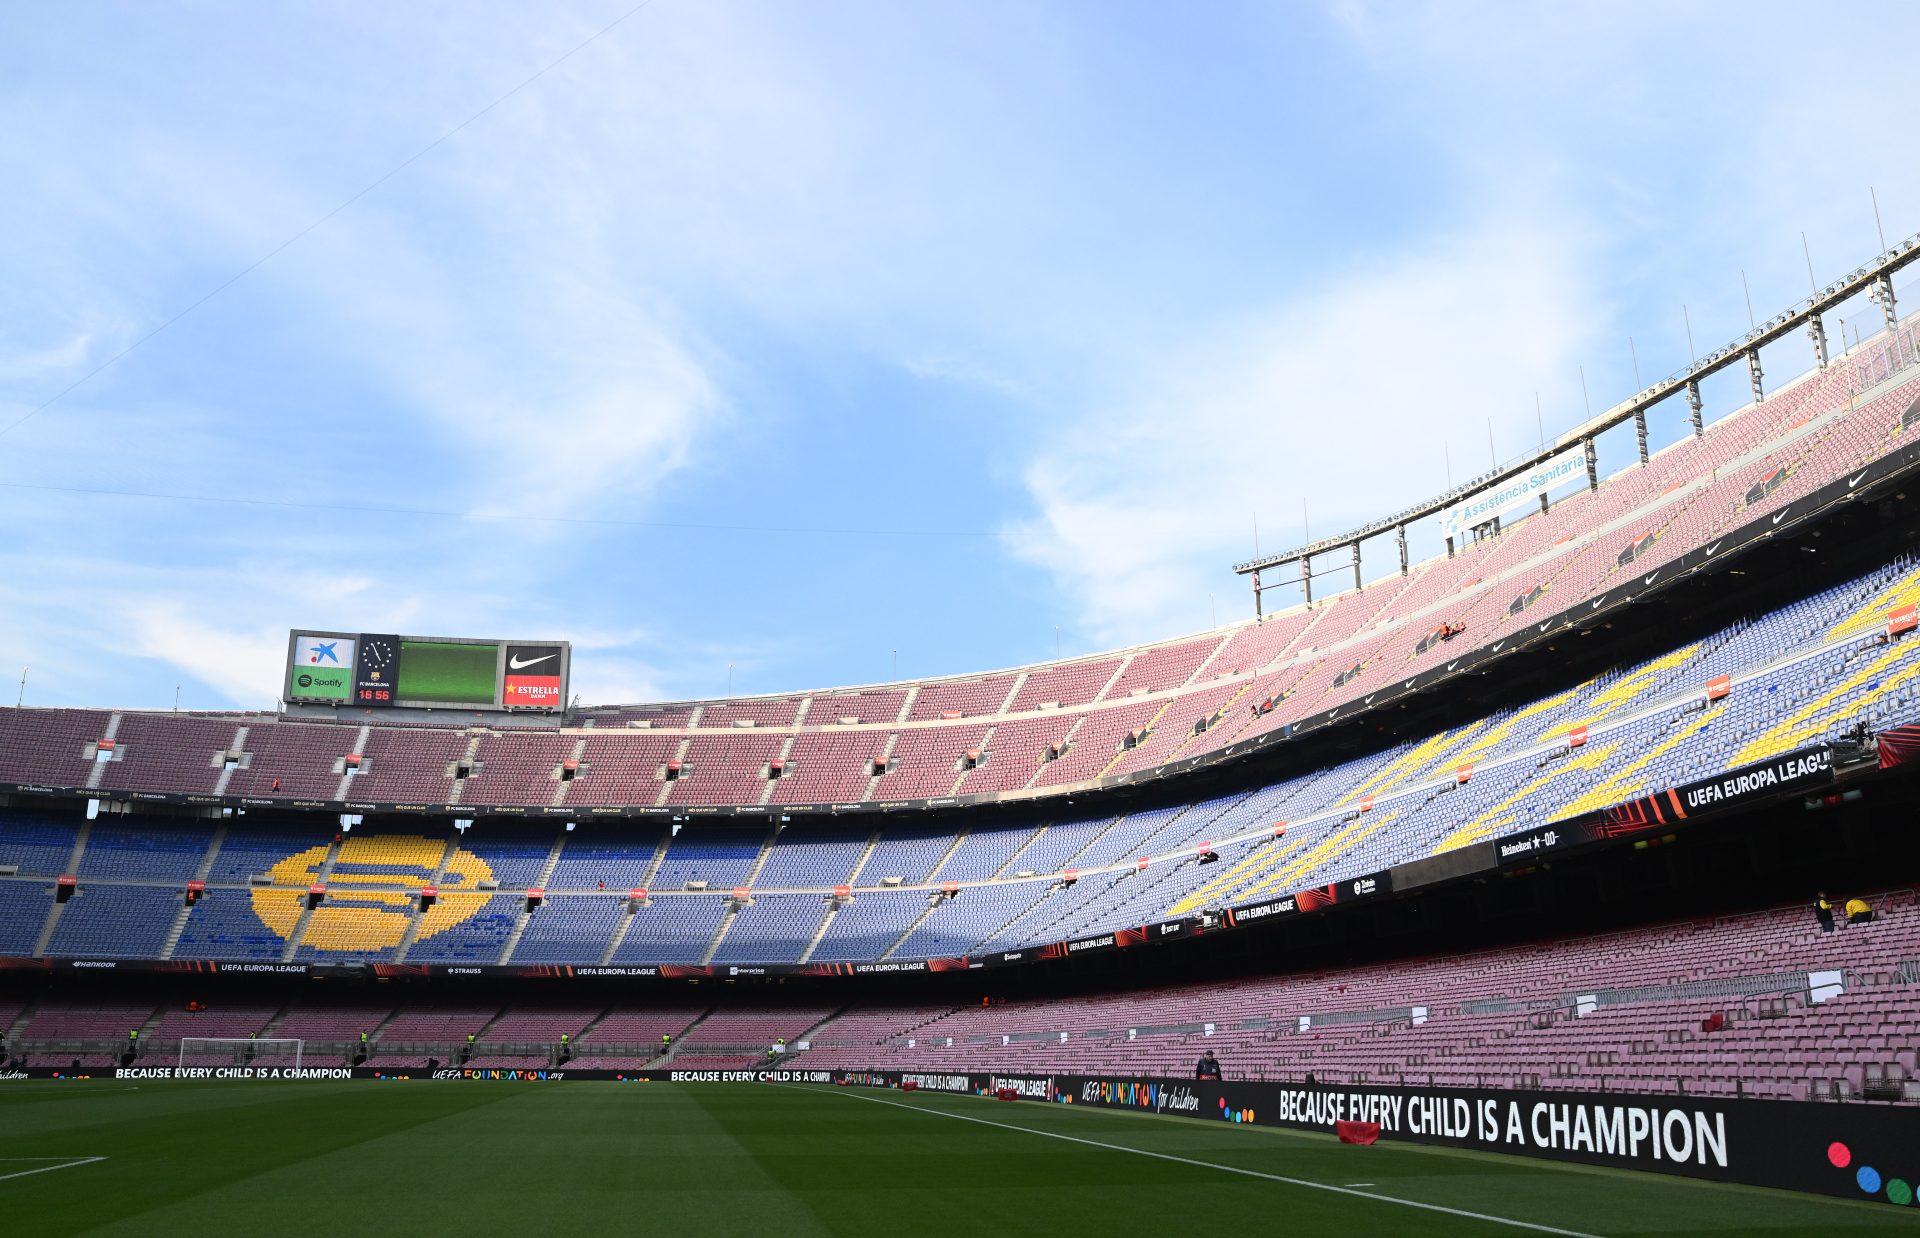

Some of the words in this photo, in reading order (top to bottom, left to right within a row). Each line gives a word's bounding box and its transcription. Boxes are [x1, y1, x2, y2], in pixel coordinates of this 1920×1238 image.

[313, 679, 342, 688] Spotify
[518, 687, 559, 695] ESTRELLA
[1688, 784, 1723, 807] UEFA
[1724, 768, 1778, 797] EUROPA
[1778, 750, 1832, 781] LEAGU
[1501, 841, 1532, 856] Heineken
[1235, 910, 1250, 921] UEFA
[1251, 905, 1272, 918] EUROPA
[1272, 899, 1294, 914] LEAGUE
[1080, 940, 1097, 950] EUROPA
[1097, 936, 1114, 947] LEAGUE
[244, 964, 275, 972] EUROPA
[901, 962, 925, 971] LEAGUE
[116, 1068, 171, 1078] BECAUSE
[174, 1068, 213, 1078] EVERY
[216, 1068, 253, 1078] CHILD
[257, 1068, 268, 1078] IS
[271, 1068, 280, 1078] A
[283, 1069, 352, 1079] CHAMPION
[432, 1070, 461, 1080] UEFA
[672, 1072, 720, 1081] BECAUSE
[723, 1072, 756, 1081] EVERY
[759, 1072, 790, 1082] CHILD
[793, 1072, 801, 1082] IS
[804, 1072, 809, 1082] A
[926, 1075, 937, 1088] CHILD
[946, 1076, 968, 1091] CHAMPION
[1026, 1080, 1046, 1096] LEAGUE
[1082, 1081, 1100, 1102] UEFA
[1101, 1082, 1157, 1105] FOUNDATION
[1158, 1084, 1168, 1113] for
[1169, 1086, 1199, 1110] children
[1280, 1090, 1345, 1126] BECAUSE
[1349, 1094, 1402, 1131] EVERY
[1408, 1096, 1470, 1138] CHILD
[1477, 1099, 1499, 1141] IS
[1506, 1101, 1525, 1145] A
[1531, 1102, 1728, 1167] CHAMPION
